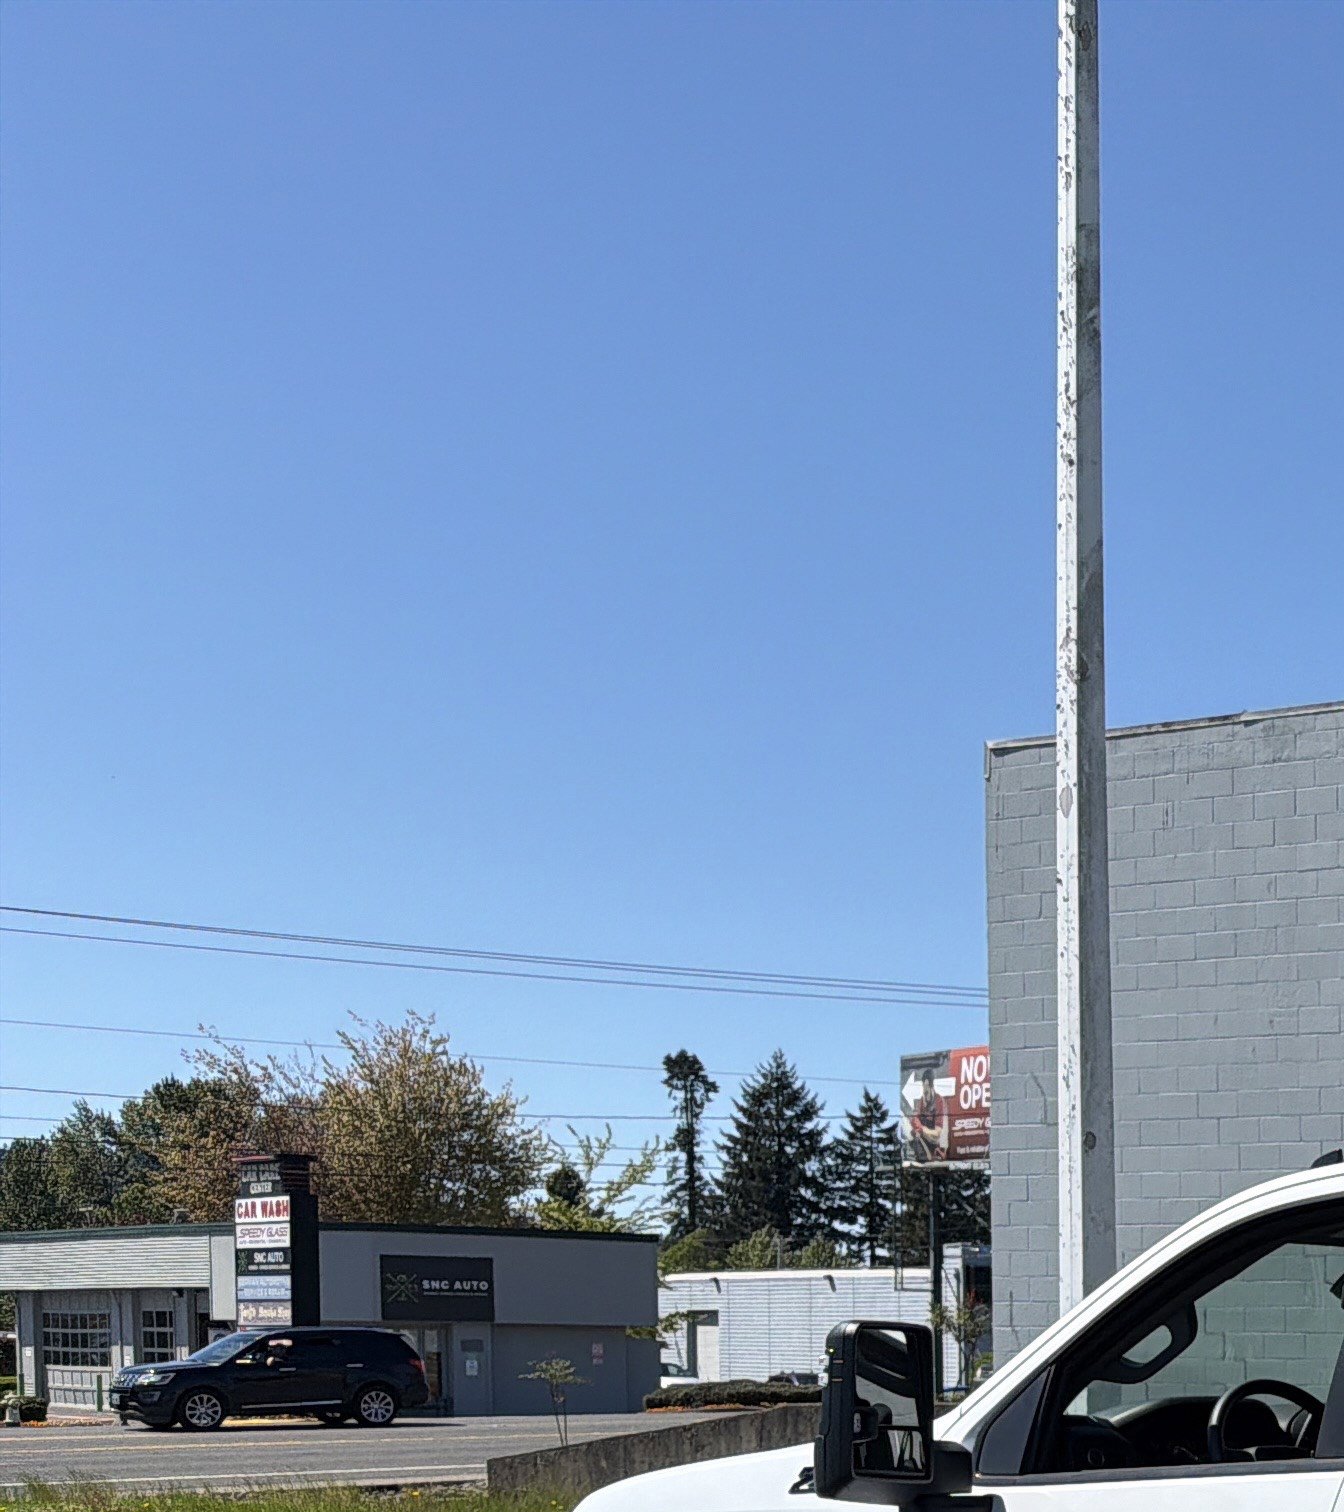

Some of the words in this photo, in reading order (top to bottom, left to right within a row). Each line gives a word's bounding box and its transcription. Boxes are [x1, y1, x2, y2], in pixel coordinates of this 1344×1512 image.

[961, 1055, 990, 1084] NO
[960, 1083, 991, 1110] OPE
[237, 1201, 257, 1219] CAR
[261, 1200, 289, 1218] WASH
[238, 1228, 266, 1239] SPEEDY
[266, 1226, 288, 1238] GLASS
[267, 1251, 284, 1263] AUTO
[422, 1280, 450, 1290] SNC
[453, 1280, 489, 1291] AUTO
